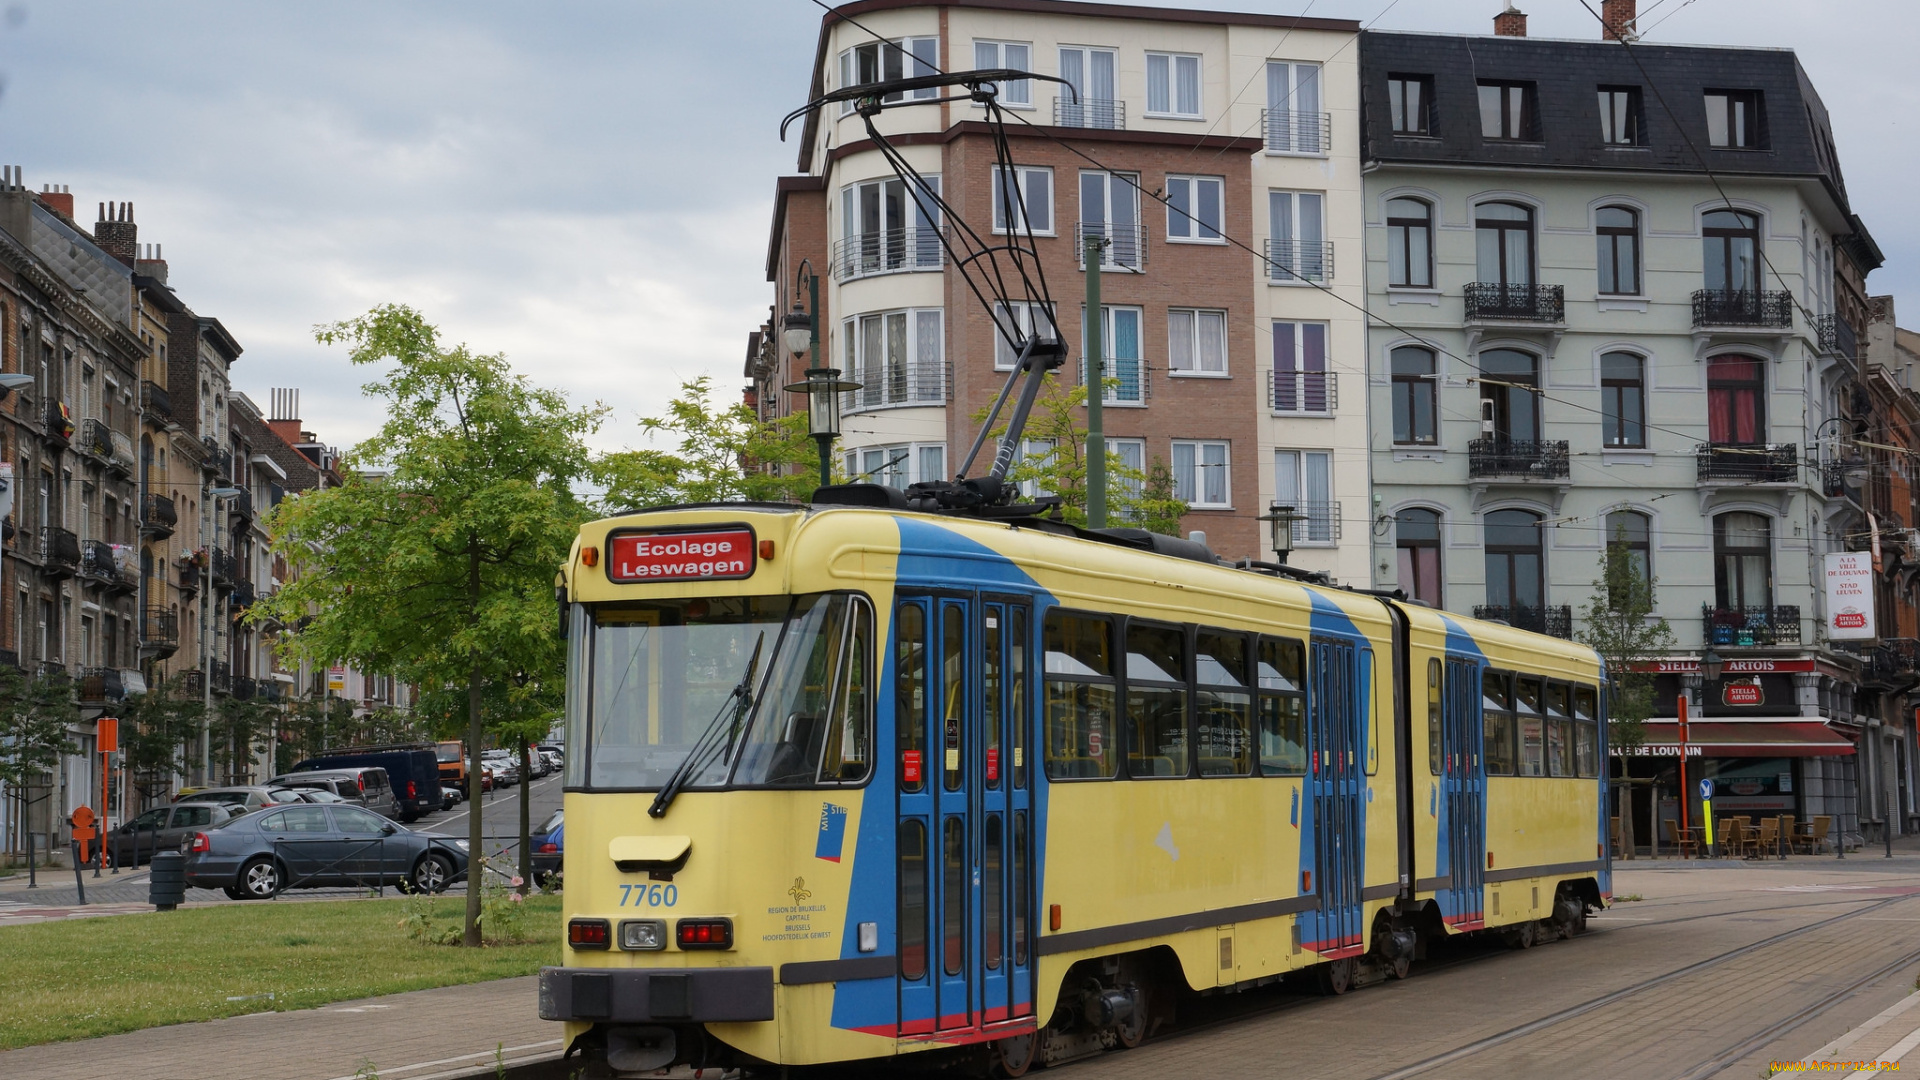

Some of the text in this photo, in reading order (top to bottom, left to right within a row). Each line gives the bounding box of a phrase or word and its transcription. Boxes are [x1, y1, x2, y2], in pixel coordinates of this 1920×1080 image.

[635, 540, 732, 557] Ecolage
[622, 560, 744, 576] Leswagen
[1659, 661, 1775, 671] STELLA ARTOIS
[1635, 747, 1649, 756] DE
[821, 803, 829, 831] MIVB
[619, 884, 678, 907] 7760
[798, 905, 826, 913] BRUXELLES
